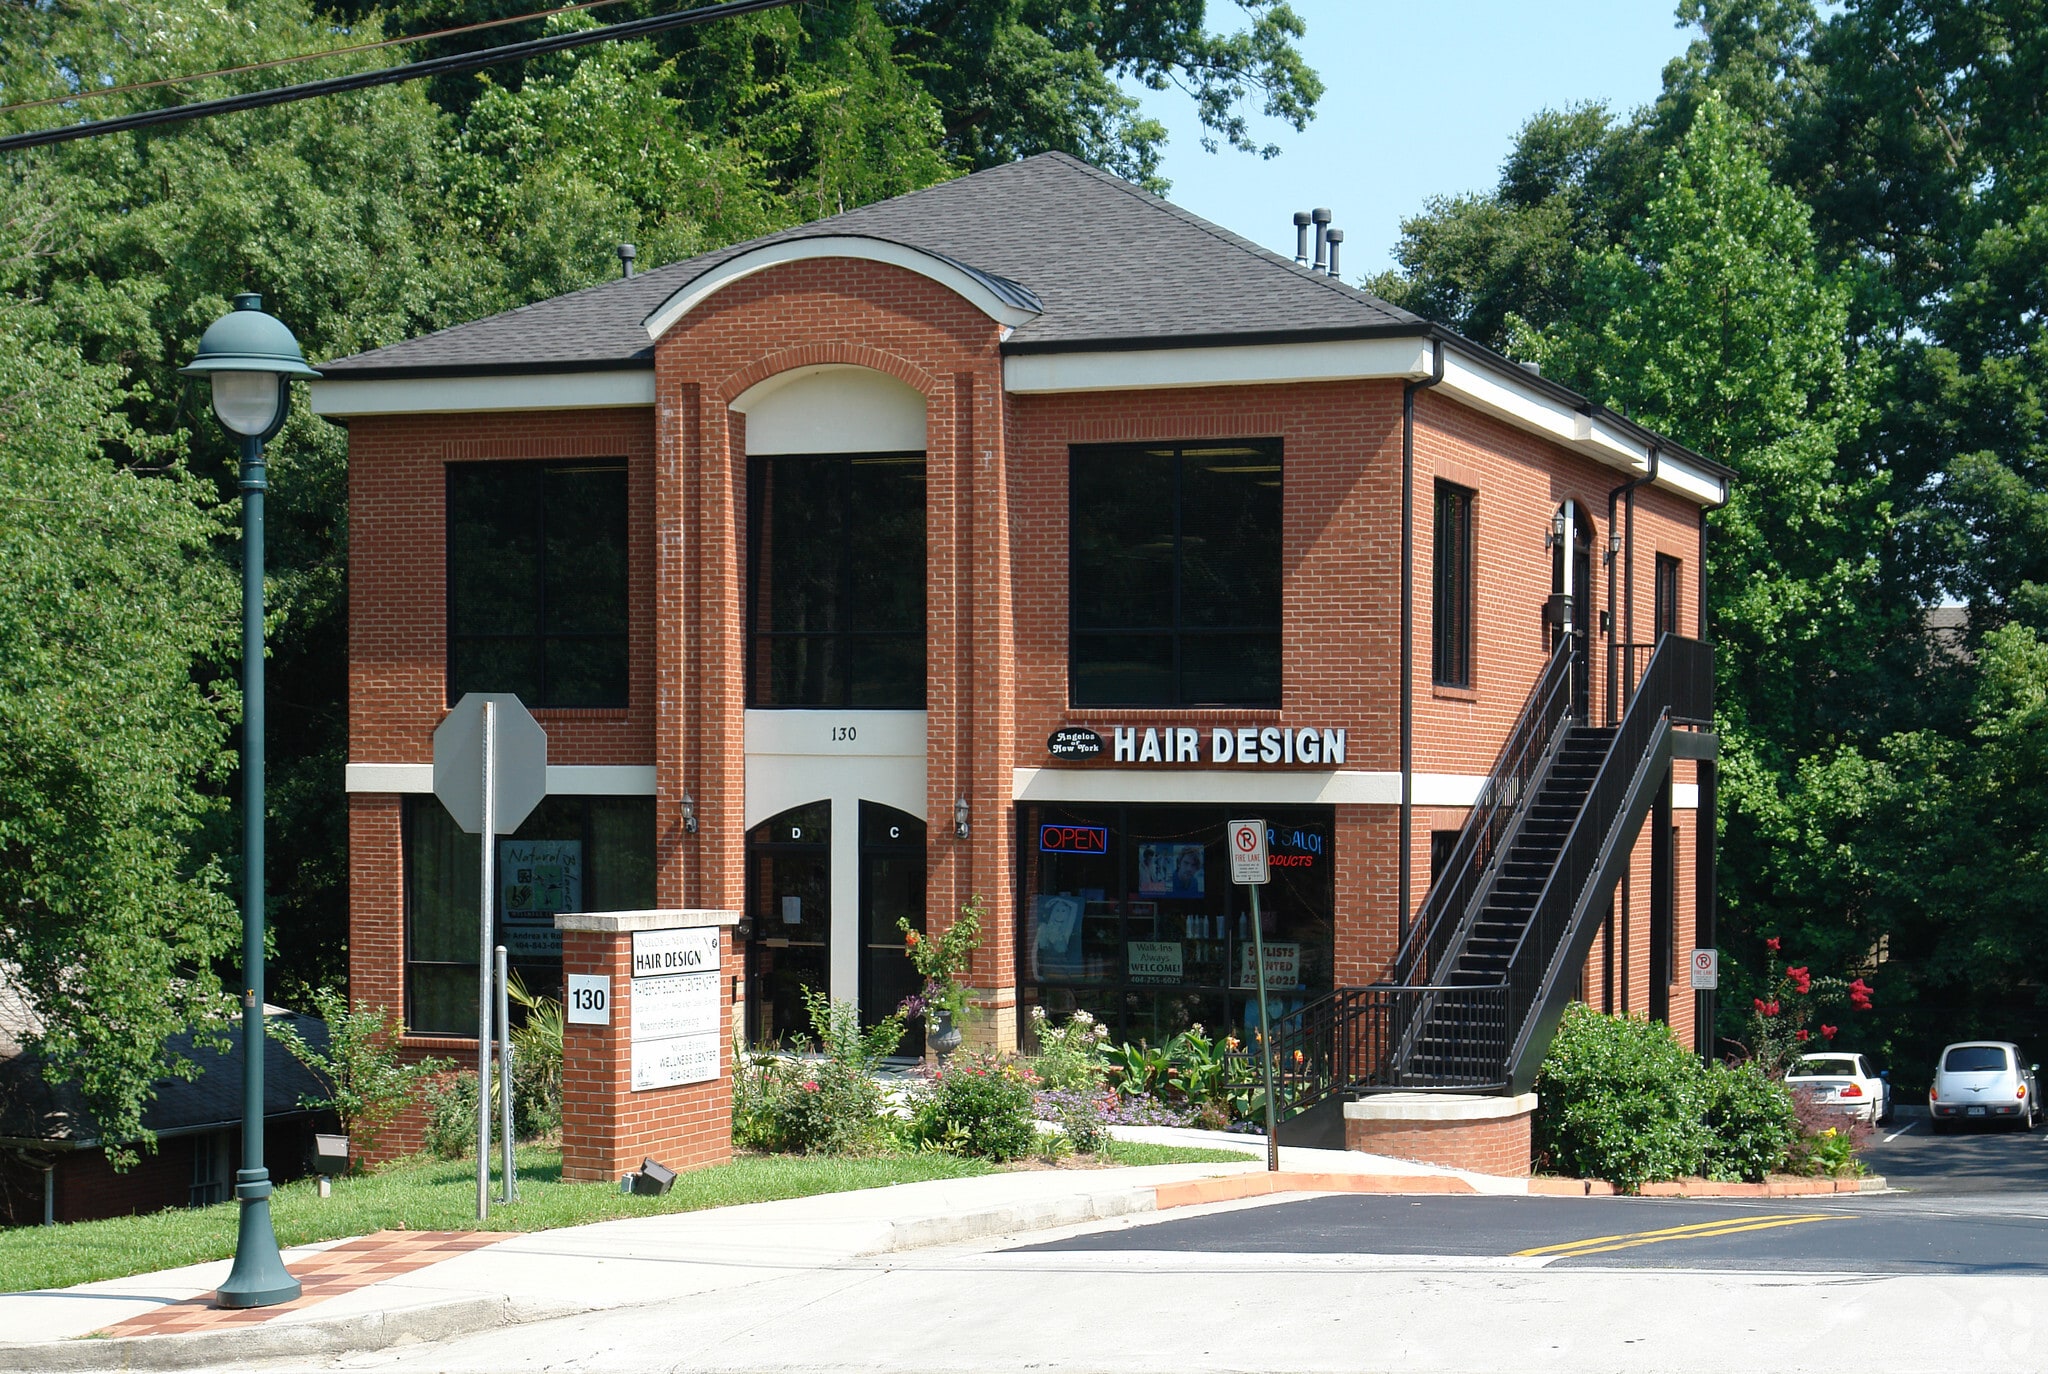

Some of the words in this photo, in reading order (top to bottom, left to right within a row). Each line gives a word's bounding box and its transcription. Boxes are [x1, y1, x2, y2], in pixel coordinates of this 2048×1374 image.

[832, 726, 857, 741] 130
[1056, 732, 1095, 742] Angelos
[1052, 744, 1075, 753] New
[1077, 744, 1099, 753] York
[1114, 727, 1200, 763] HAIR
[1212, 726, 1346, 764] DESIGN
[791, 827, 801, 839] D
[889, 826, 900, 838] C
[1043, 827, 1104, 850] OPEN
[508, 846, 562, 865] Natural
[1235, 854, 1246, 863] FIRE
[1247, 853, 1261, 862] LANE
[1268, 854, 1313, 867] ODUCTS
[513, 931, 541, 939] Andrea
[1248, 946, 1294, 957] SLISTS
[636, 953, 662, 970] HAIR
[665, 949, 702, 968] DESIGN
[1140, 953, 1171, 964] Always
[1130, 963, 1180, 973] WELCOME!
[1248, 960, 1293, 971] WNTED
[1243, 974, 1296, 985] 25-6025
[572, 988, 605, 1011] 130
